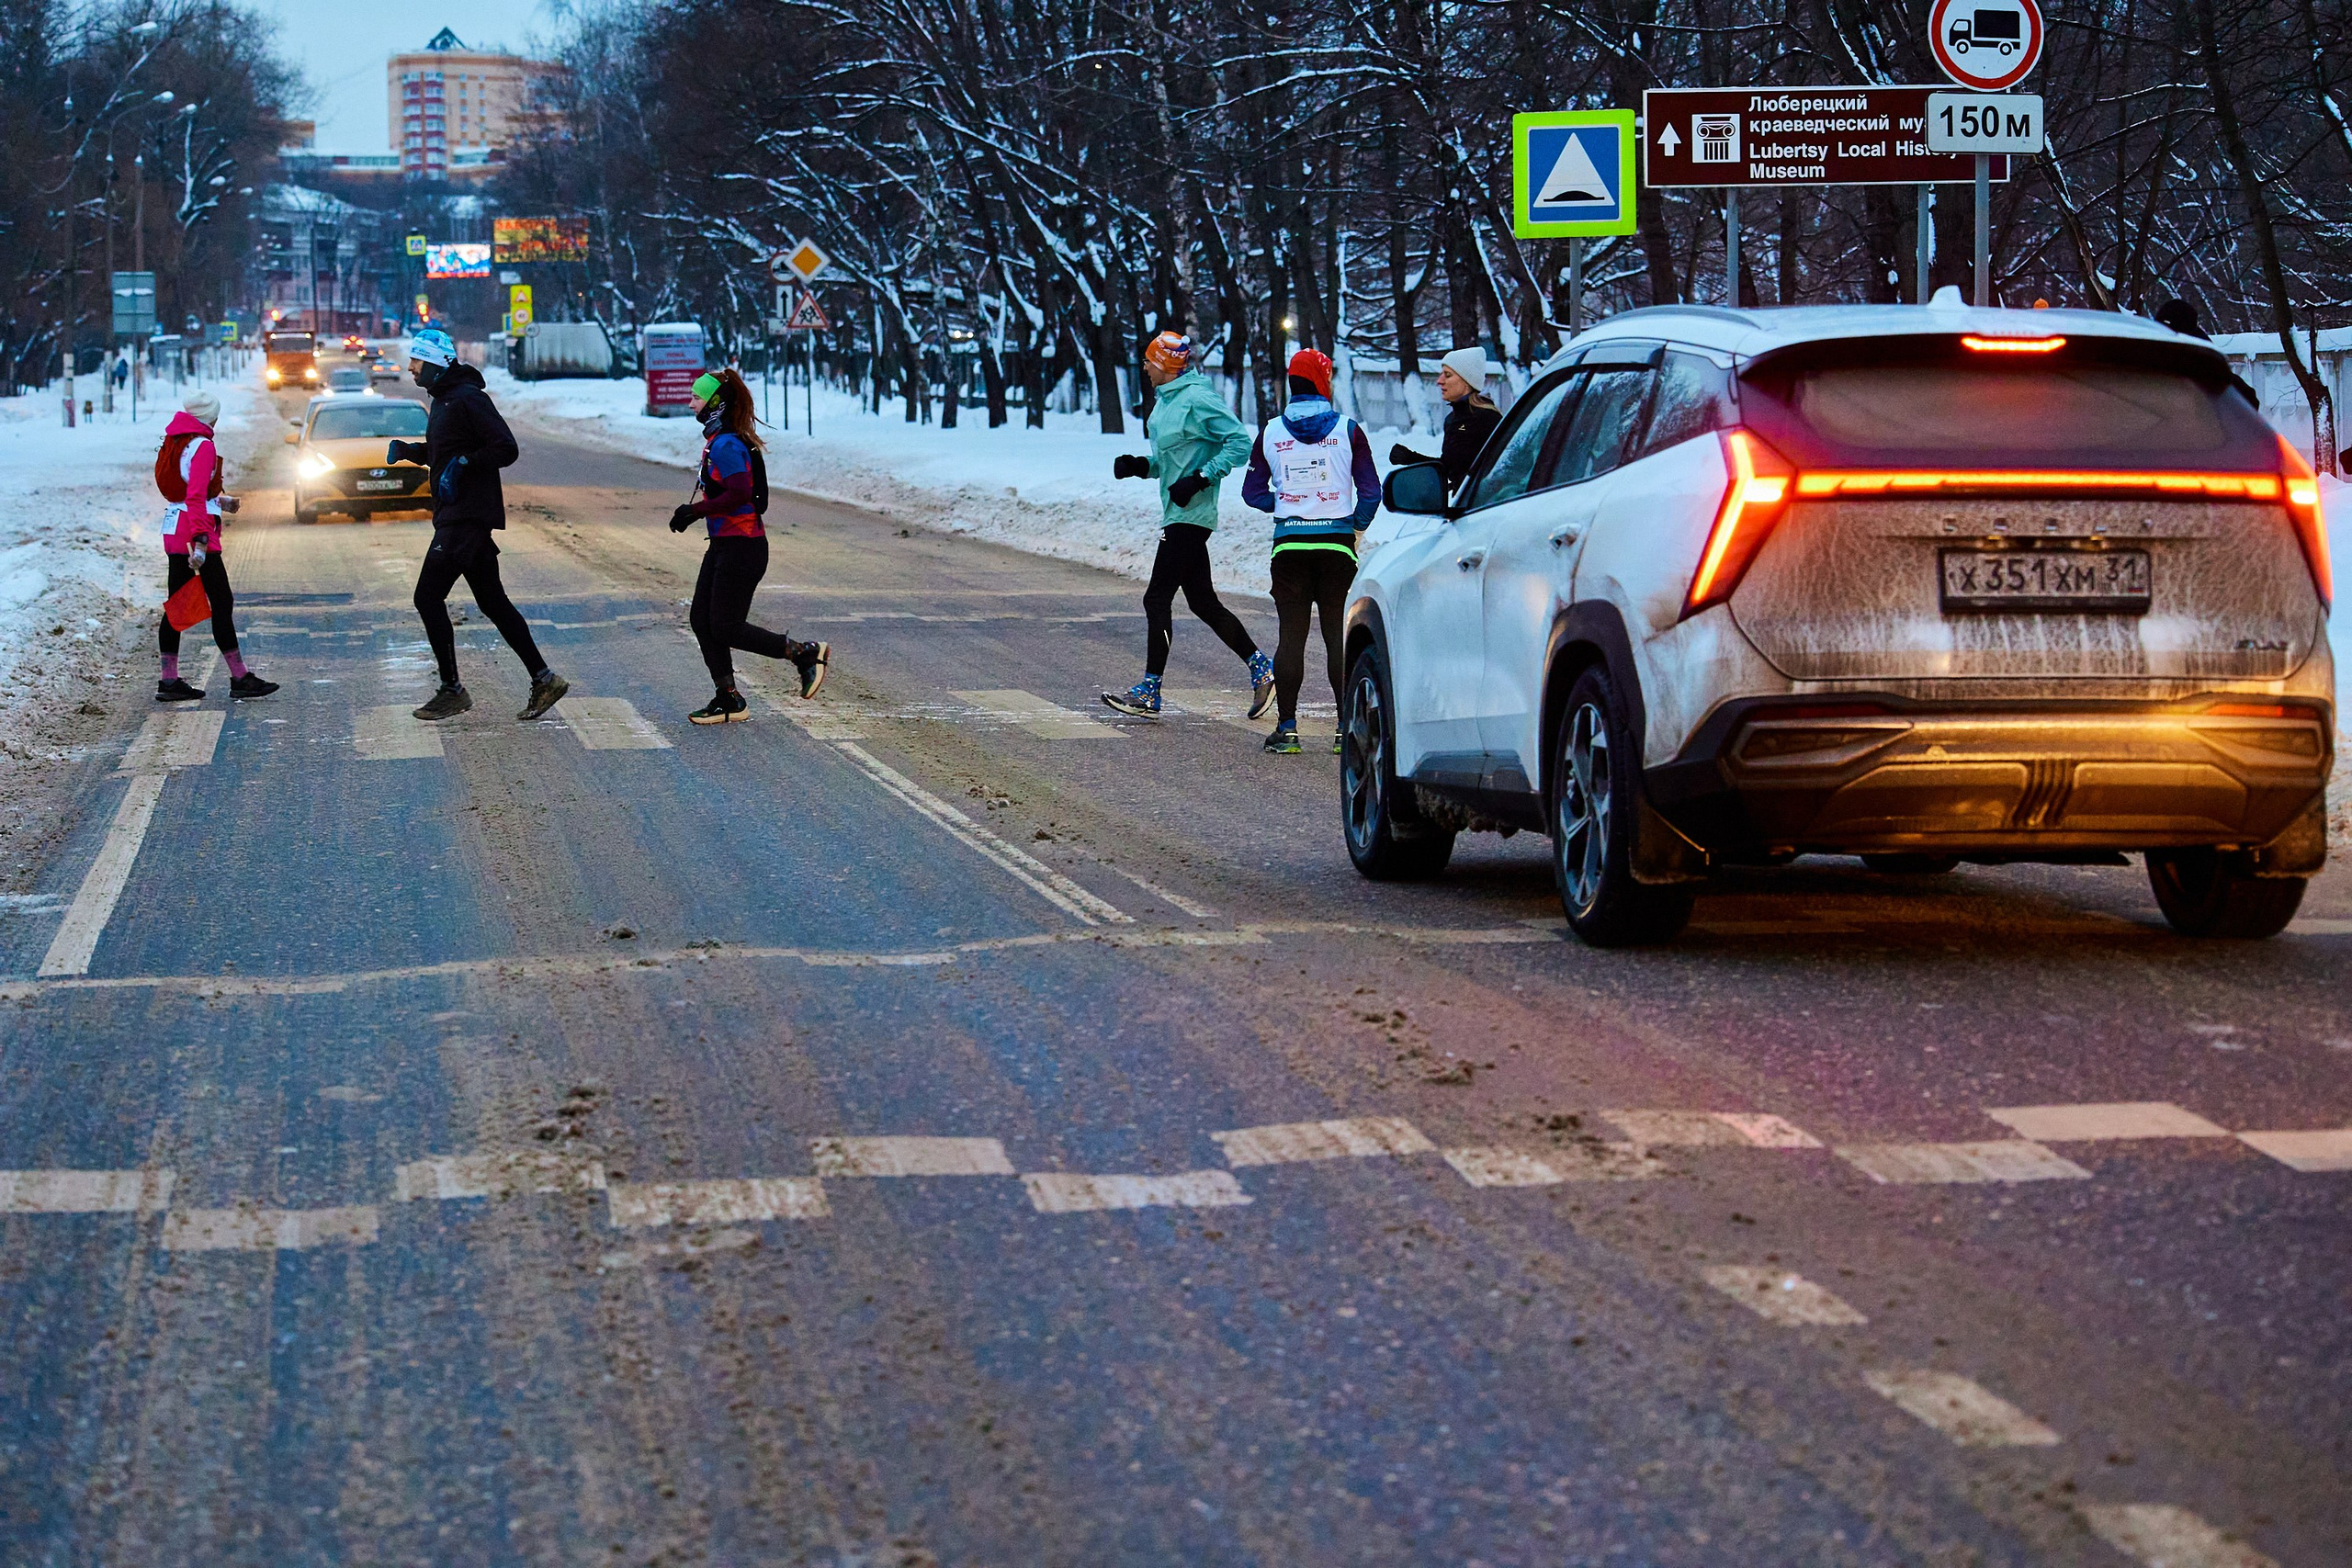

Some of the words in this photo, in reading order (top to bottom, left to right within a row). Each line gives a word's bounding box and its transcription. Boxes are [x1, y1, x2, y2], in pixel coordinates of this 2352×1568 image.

[1748, 94, 1868, 115] Люберецкий
[1749, 114, 1890, 137] краеведческий
[1899, 117, 1927, 134] му
[1939, 105, 1999, 138] 150
[1749, 142, 1828, 162] Lubertsy
[1838, 141, 1886, 158] Local
[1749, 163, 1826, 179] Museum
